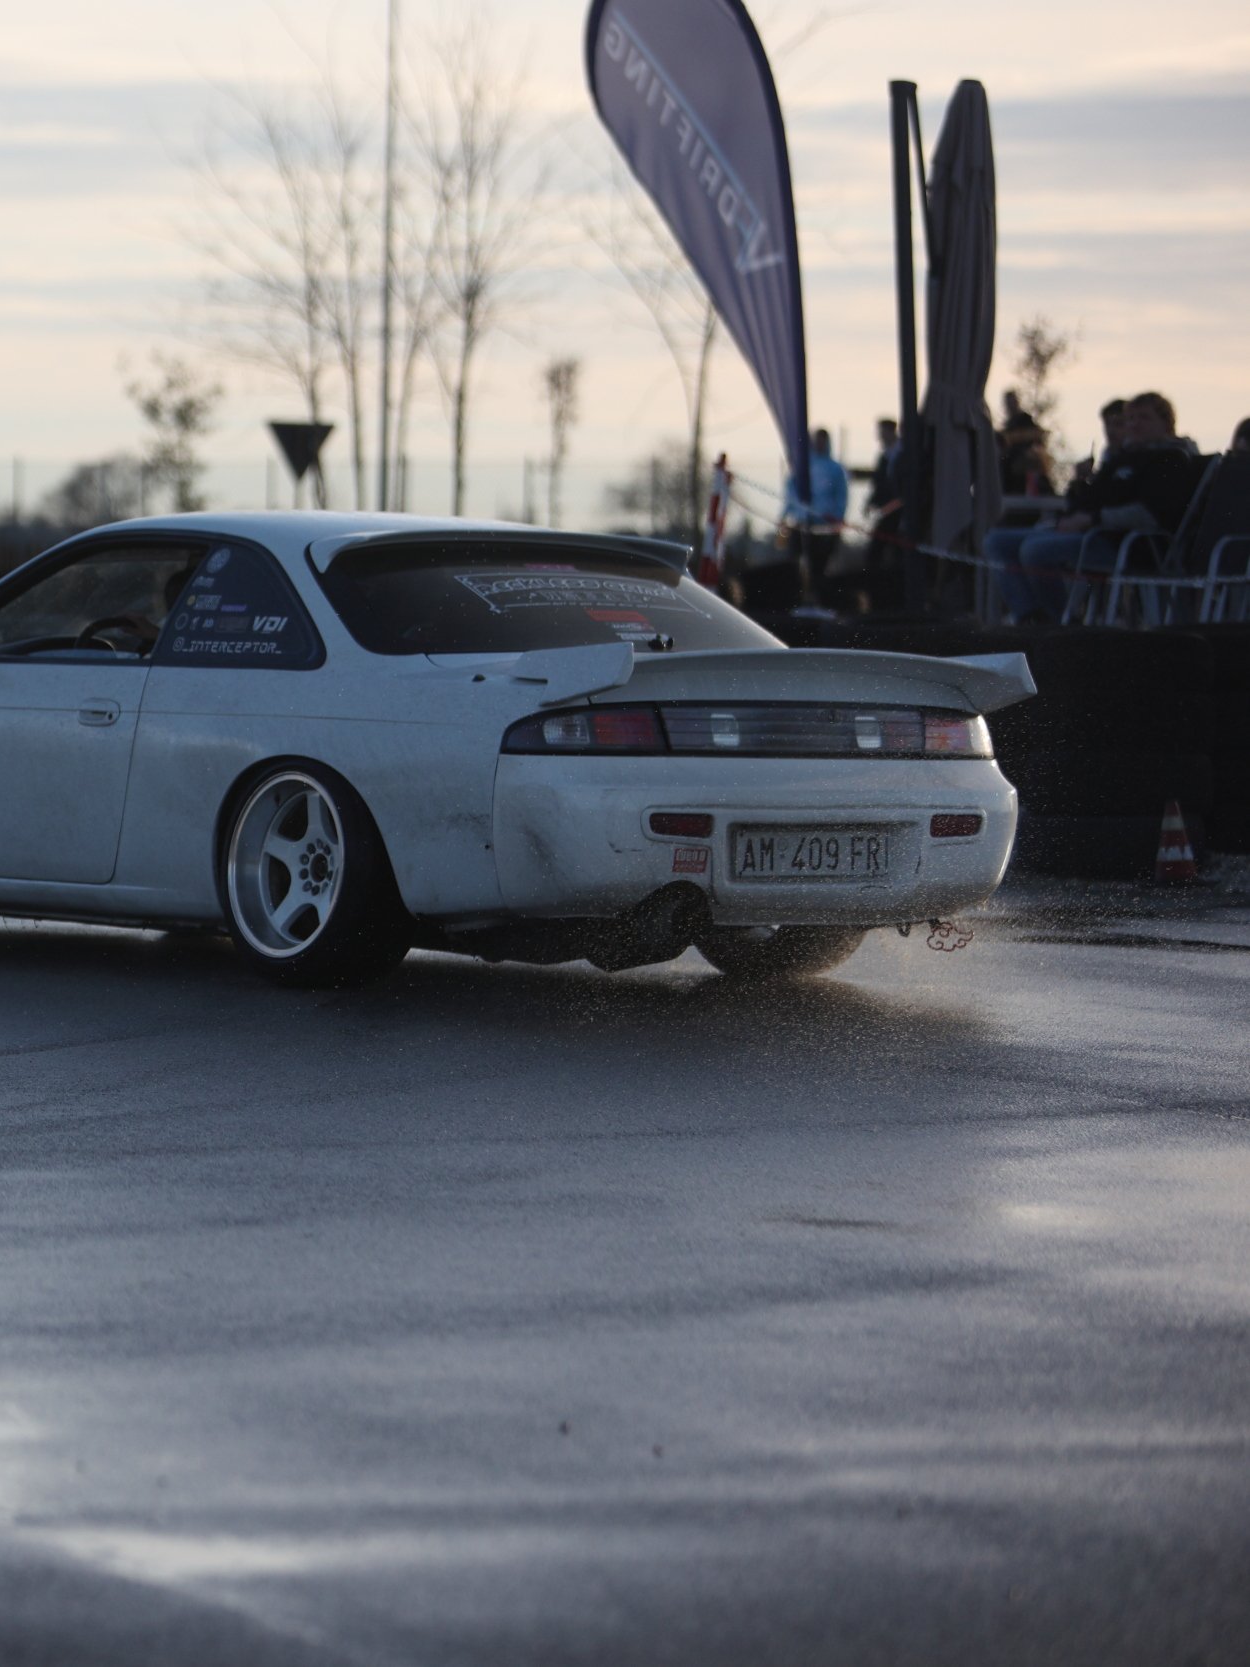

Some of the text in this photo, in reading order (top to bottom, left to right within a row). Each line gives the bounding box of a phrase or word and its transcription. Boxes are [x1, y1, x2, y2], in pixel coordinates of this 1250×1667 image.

[252, 615, 288, 633] VDI
[743, 836, 881, 872] AM 409 FR
